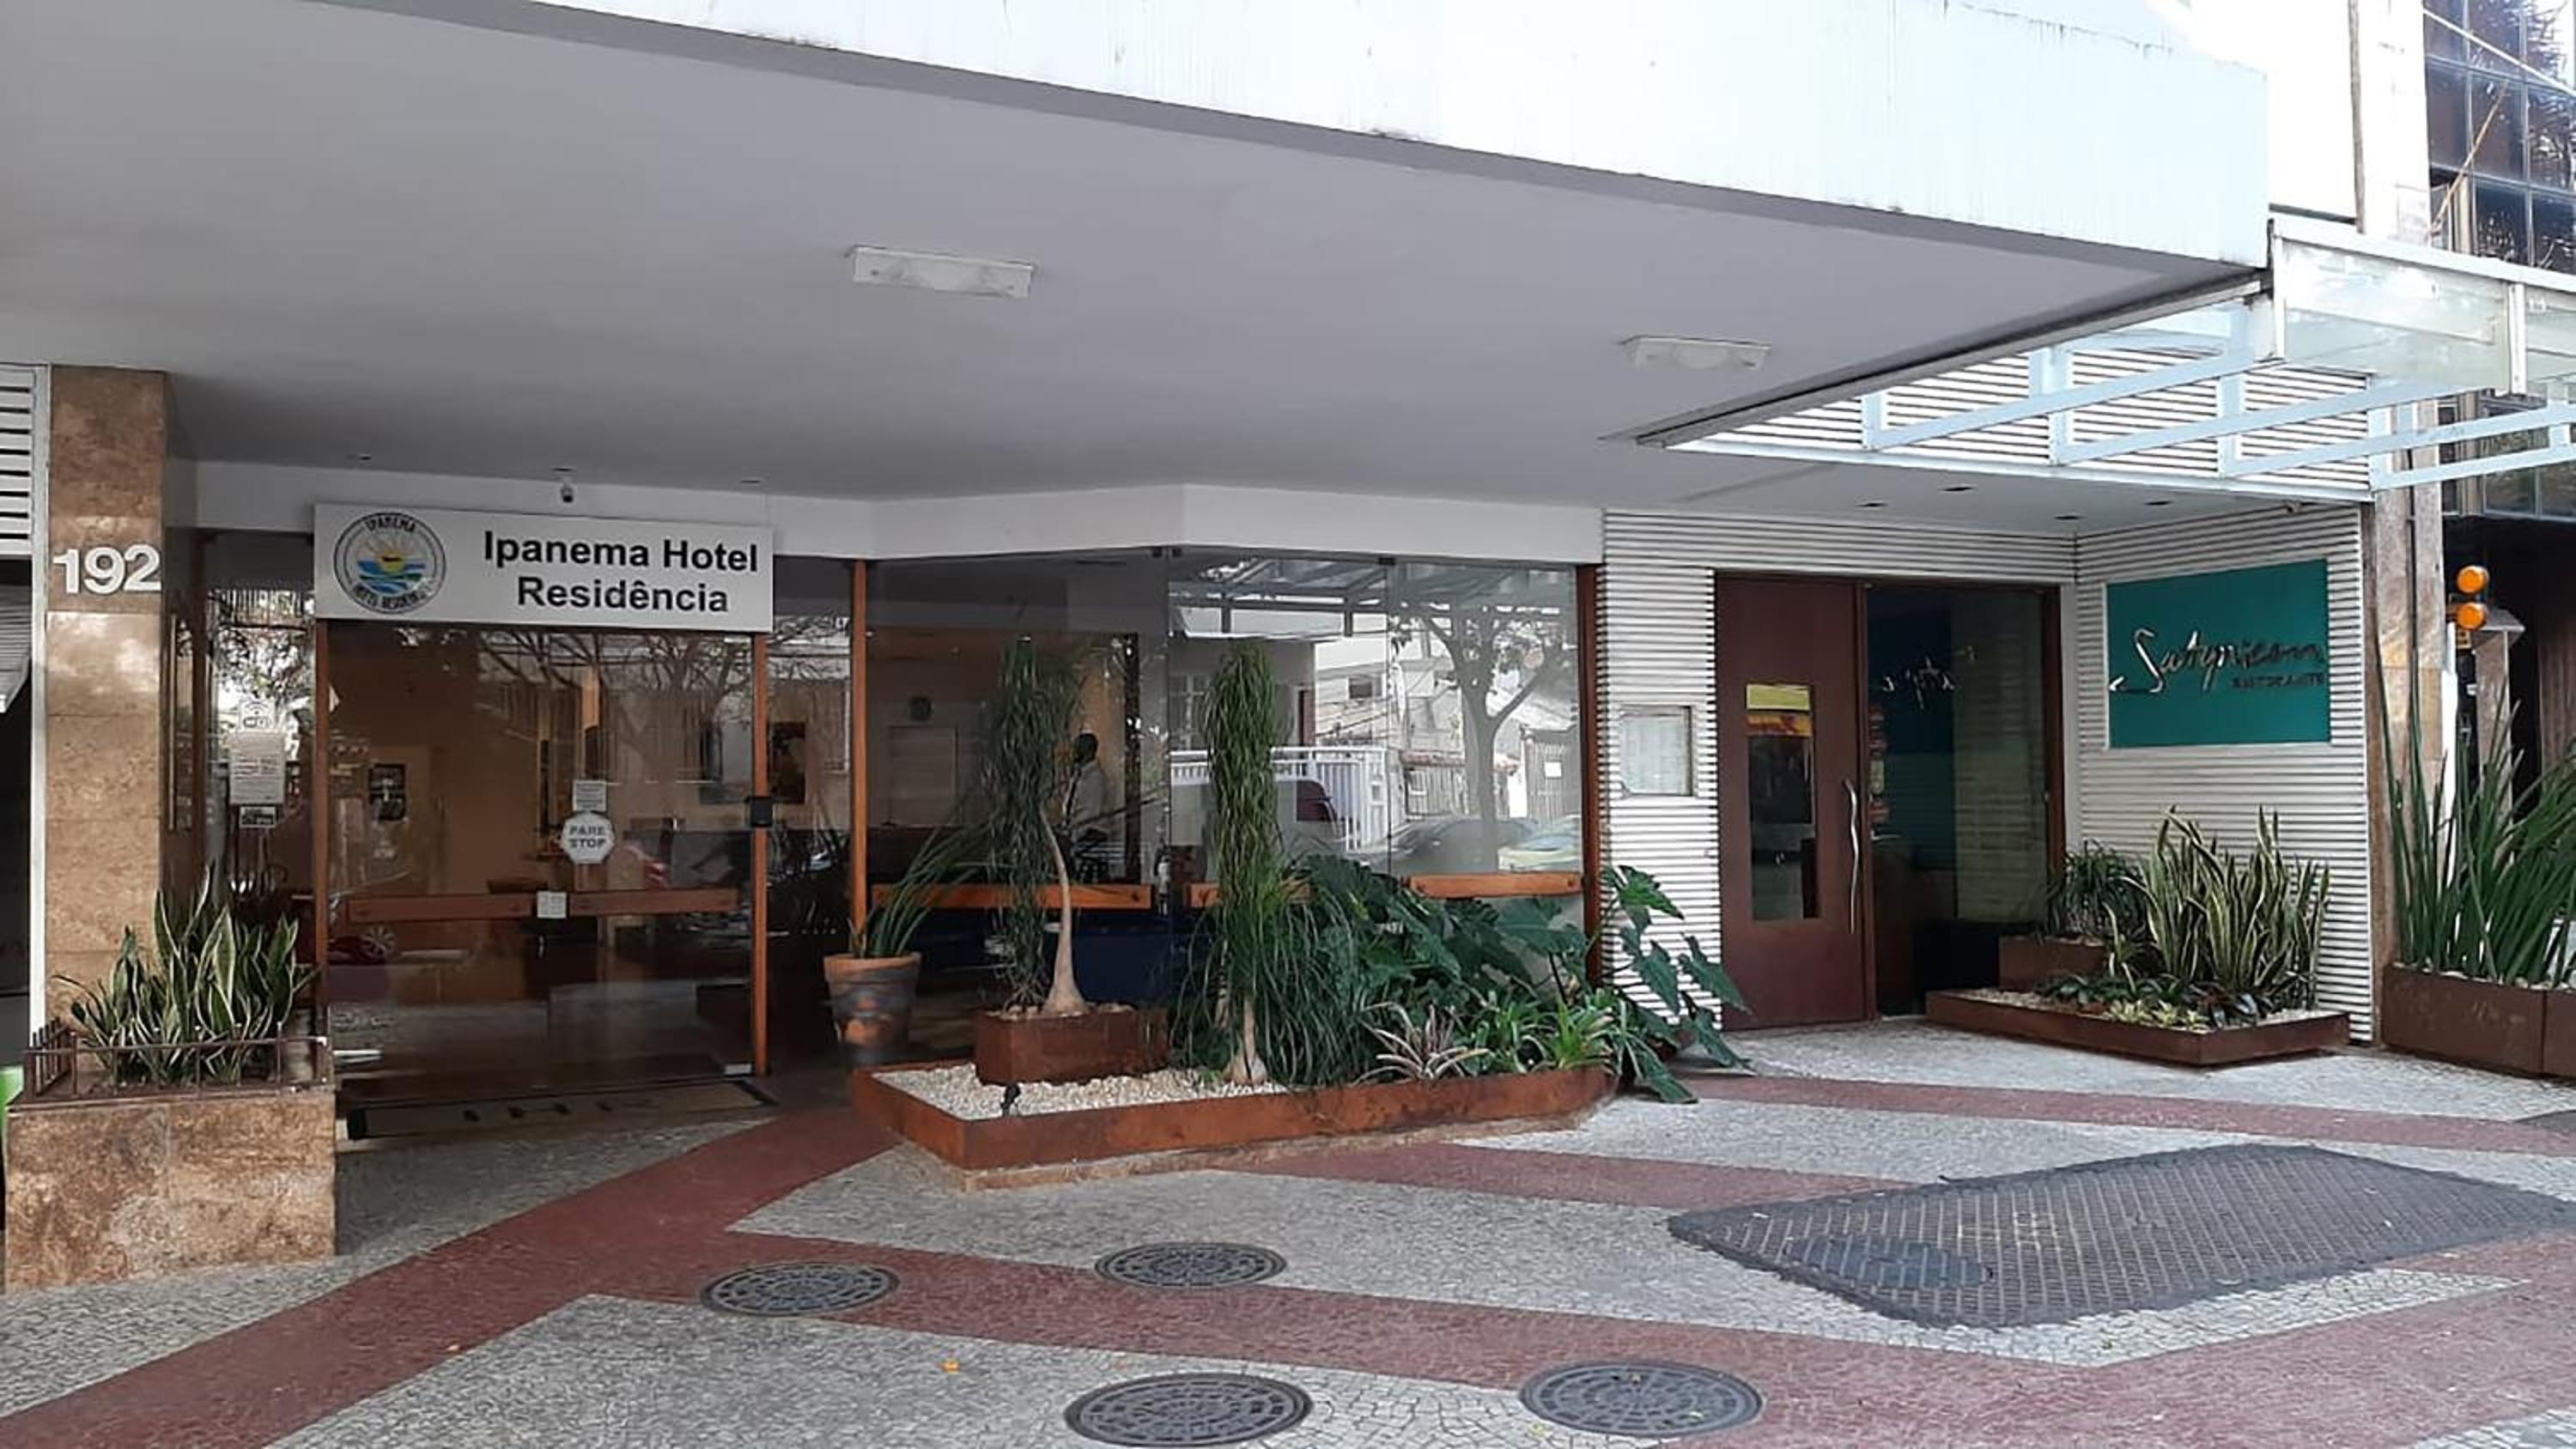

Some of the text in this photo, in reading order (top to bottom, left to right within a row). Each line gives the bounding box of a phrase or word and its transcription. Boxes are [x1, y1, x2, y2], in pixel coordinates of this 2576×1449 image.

[52, 543, 162, 595] 192
[484, 530, 758, 573] Ipanema Hotel
[517, 574, 729, 612] Residência
[568, 826, 606, 836] PARE
[568, 838, 606, 849] STOP
